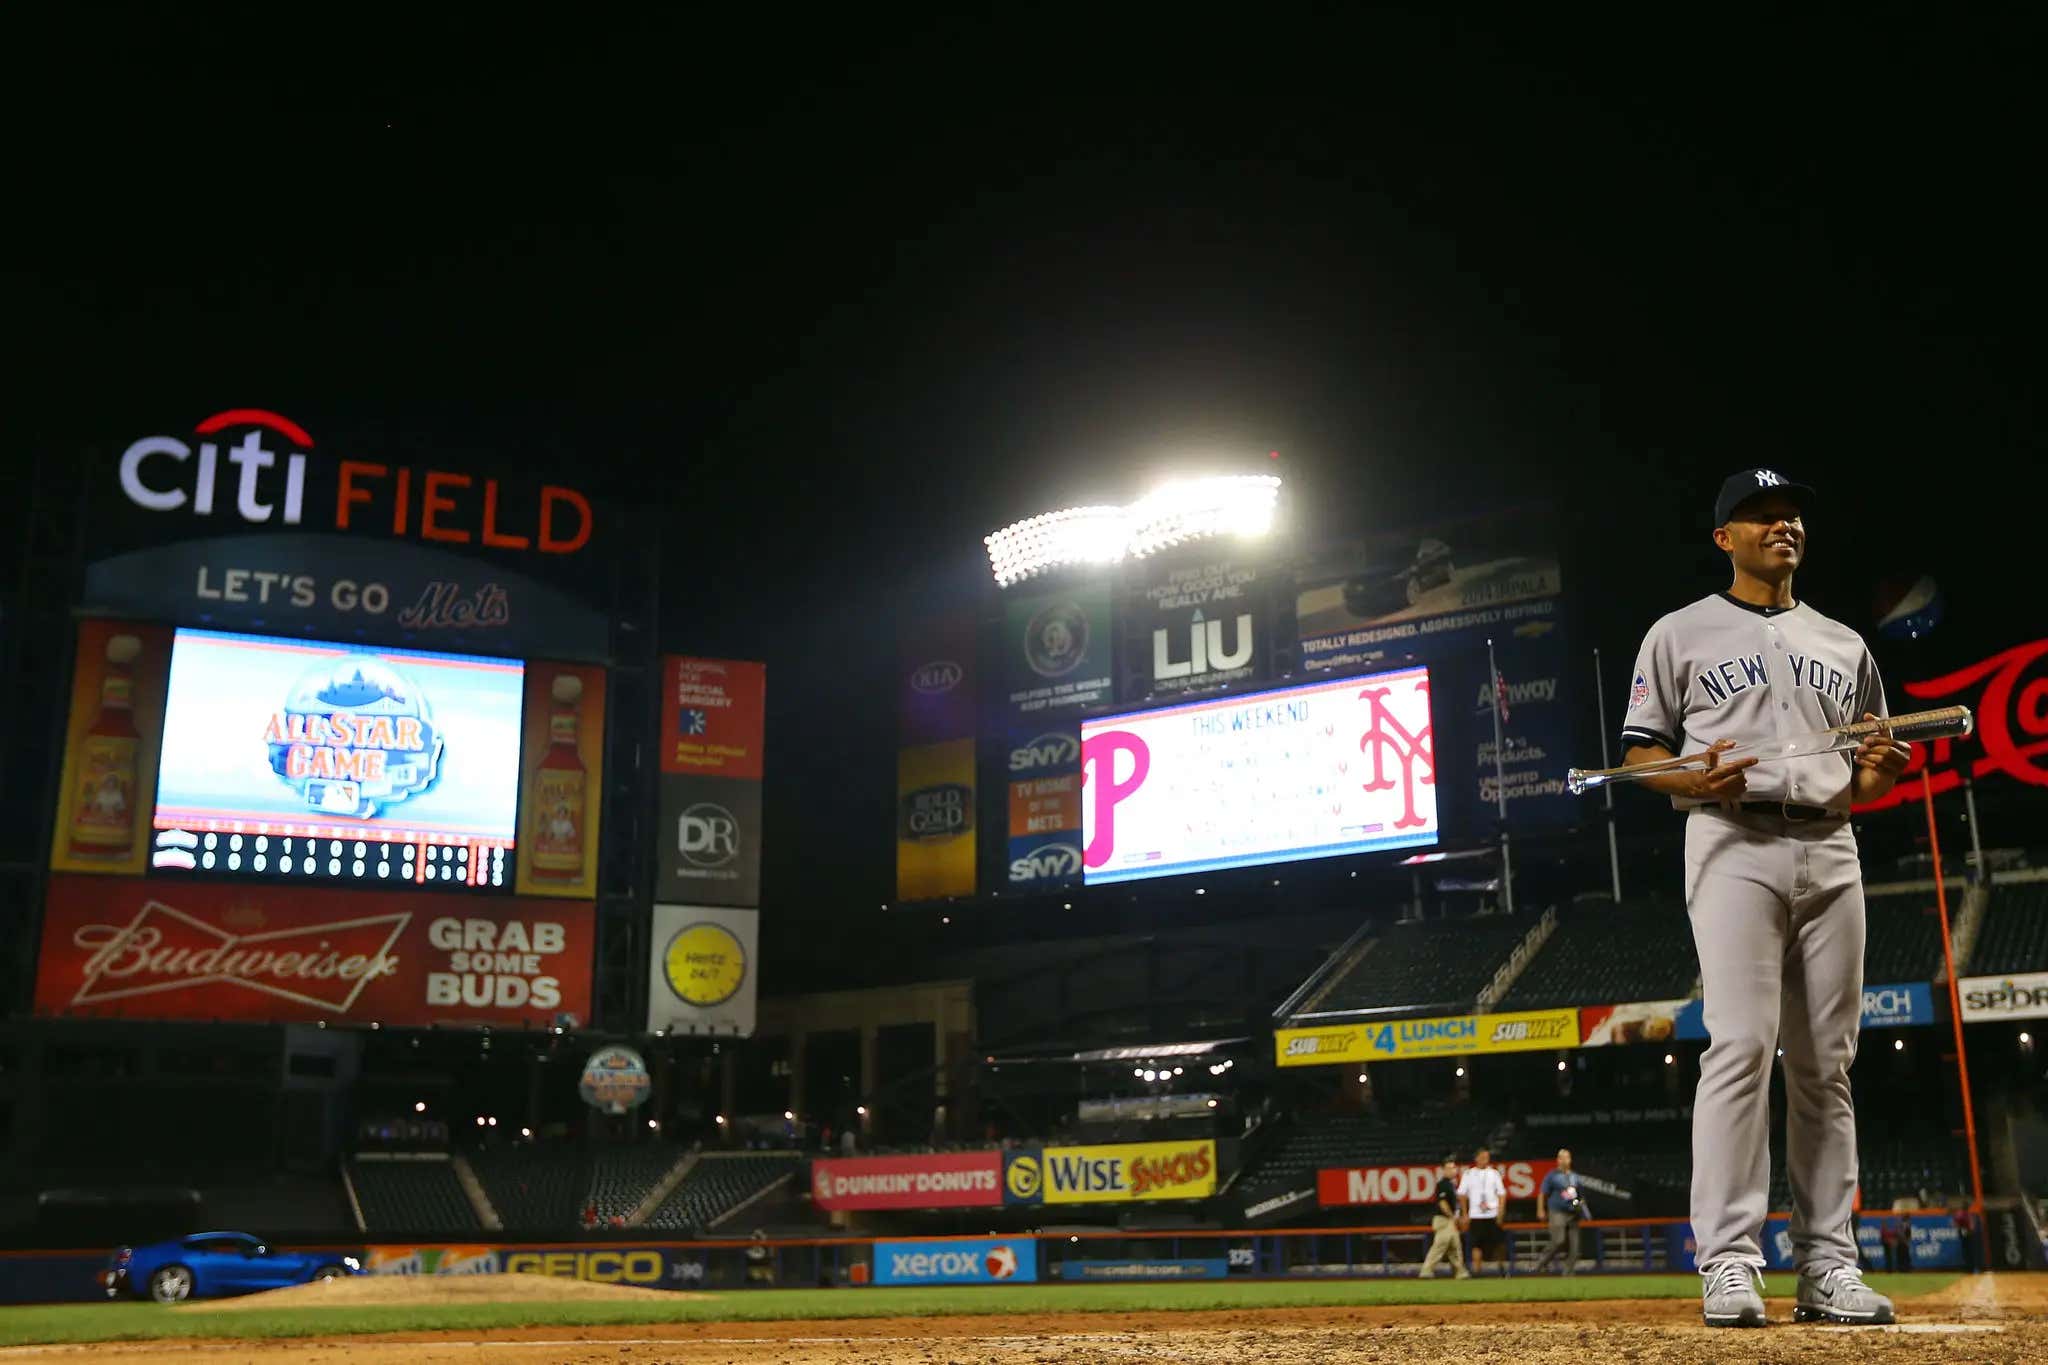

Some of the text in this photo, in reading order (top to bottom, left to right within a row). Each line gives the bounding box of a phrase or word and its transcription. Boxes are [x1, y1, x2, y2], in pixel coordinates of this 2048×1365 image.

[336, 460, 593, 554] FIELD
[196, 566, 509, 629] LET'S GO Mets
[1302, 635, 1348, 653] TOTALLY
[1697, 653, 1769, 707] NEW
[1787, 653, 1857, 712] YORK
[1192, 699, 1310, 737] THIS WEEKEND
[286, 745, 387, 782] GAME
[1008, 741, 1068, 771] SNY
[1016, 782, 1033, 799] TV
[678, 815, 737, 858] DR
[1027, 814, 1064, 833] METS
[1008, 852, 1069, 882] SNY
[74, 924, 398, 979] Budweiser
[427, 917, 566, 953] GRAB
[449, 949, 541, 975] SOME
[426, 971, 561, 1010] BUDS
[1286, 1031, 1358, 1057] SUBWAY
[1401, 1018, 1477, 1043] LUNCH
[1491, 1014, 1572, 1043] SUBWAY
[915, 1169, 997, 1194] DONUTS
[1049, 1145, 1212, 1197] WISE SNACKS
[506, 1251, 664, 1283] GEICO
[891, 1246, 979, 1277] xerox
[1228, 1248, 1256, 1265] 375
